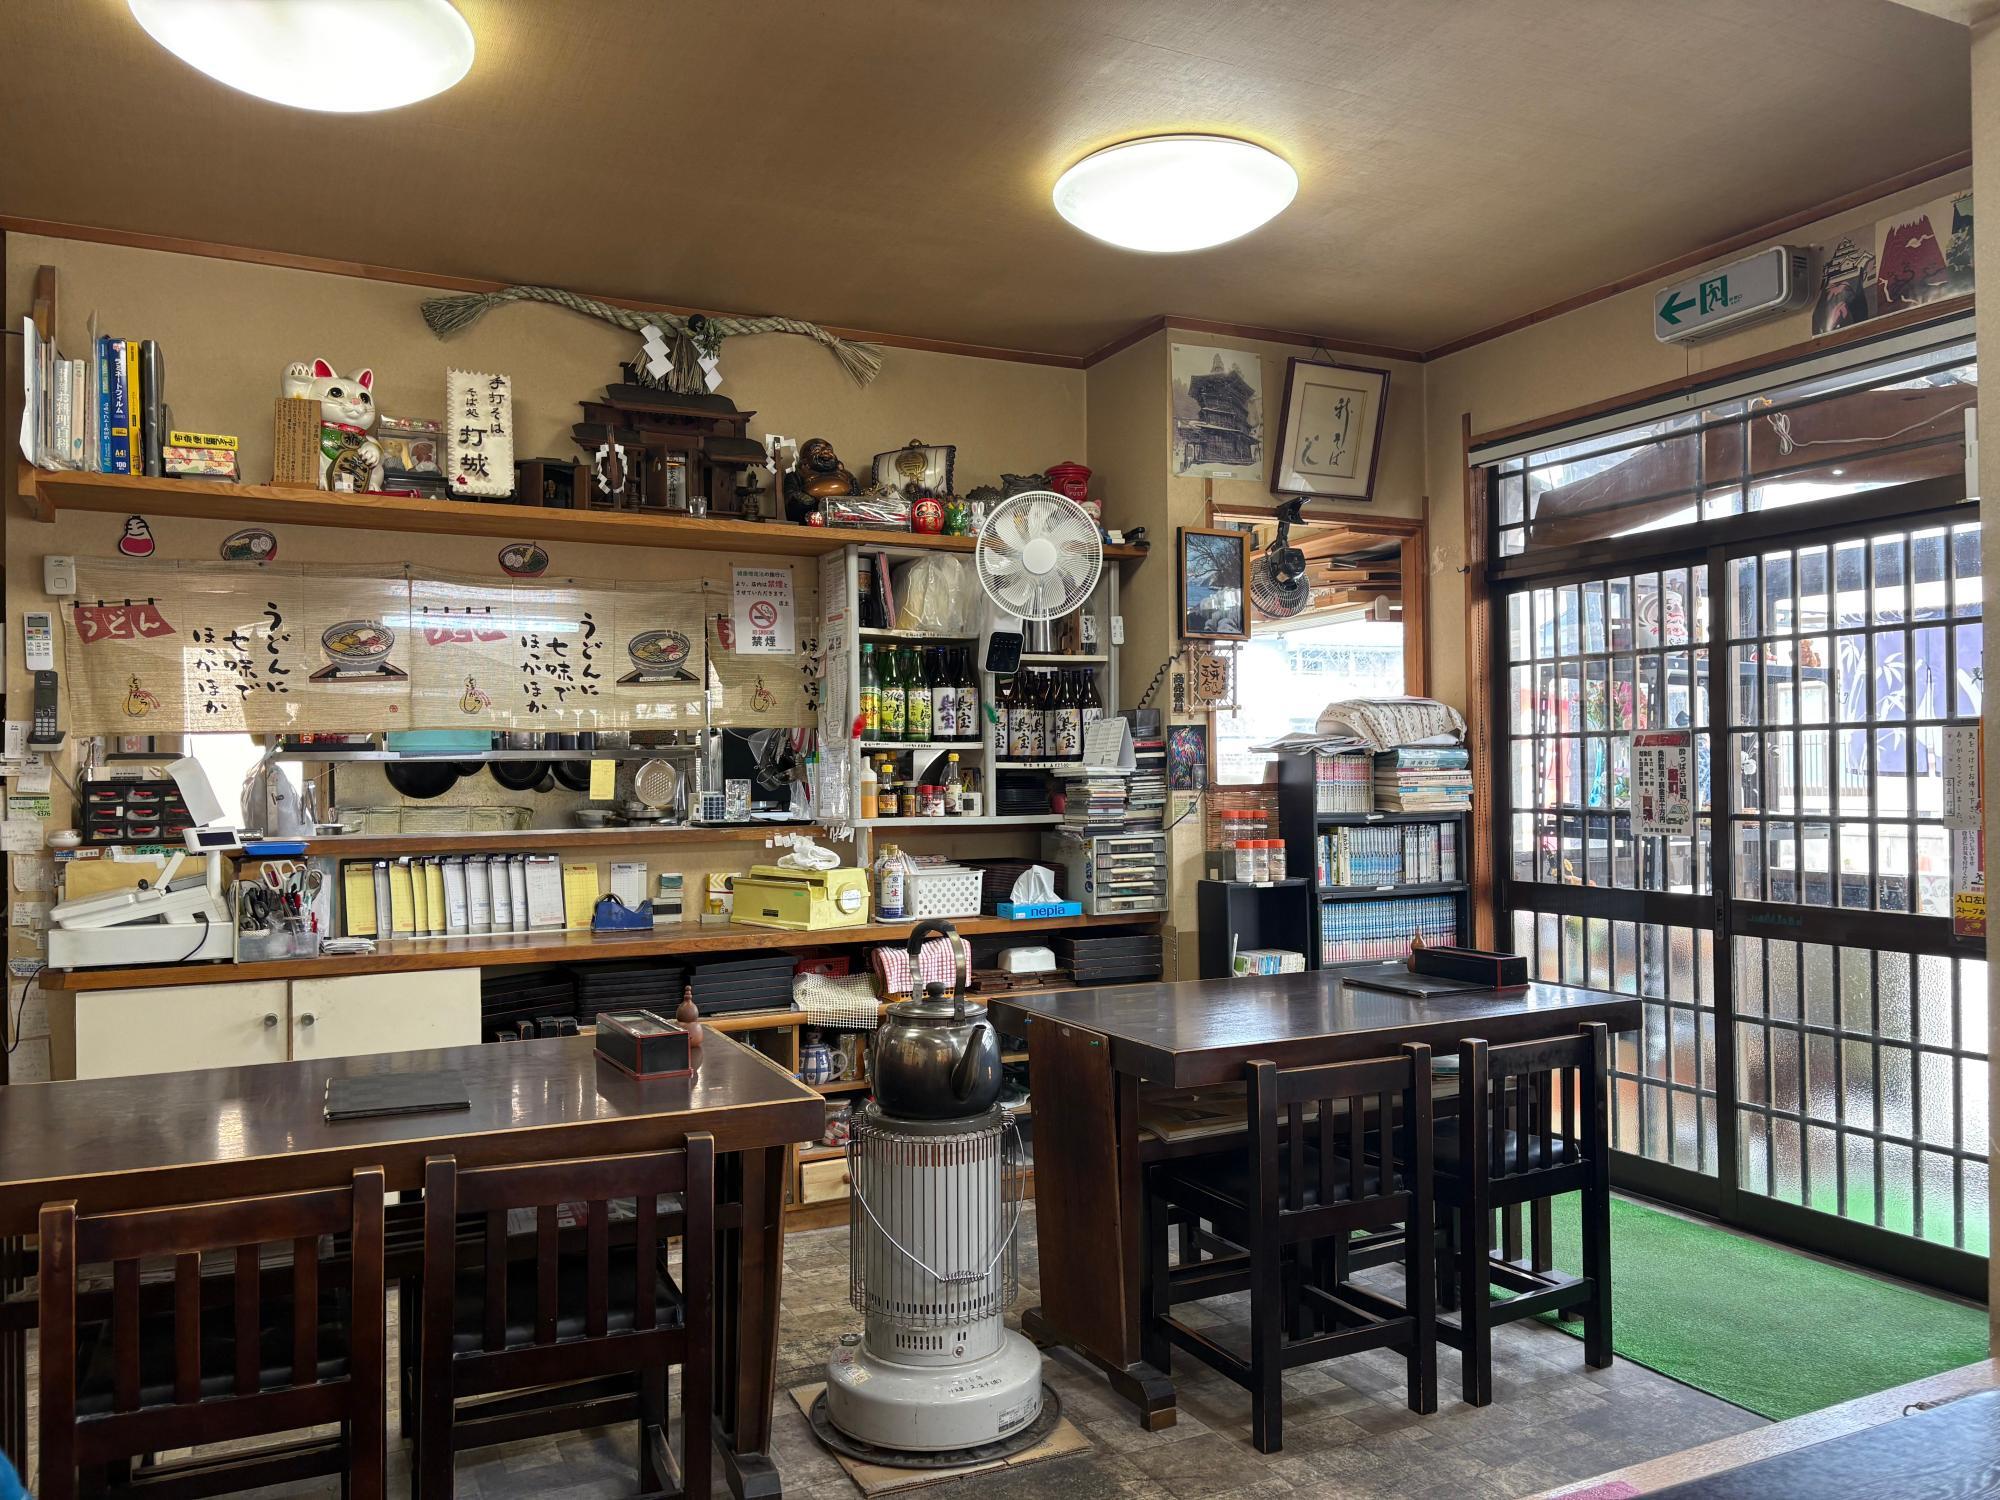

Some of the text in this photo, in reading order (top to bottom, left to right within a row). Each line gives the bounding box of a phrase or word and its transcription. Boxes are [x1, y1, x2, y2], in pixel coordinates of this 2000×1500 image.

[459, 426, 489, 478] 打城
[82, 608, 161, 637] うどん
[263, 601, 291, 694] うどんに
[751, 636, 776, 647] 禁煙
[222, 630, 261, 700] 七味で
[545, 637, 576, 702] 七味で
[580, 612, 603, 696] うどんに
[956, 695, 974, 730] 財宝
[1031, 904, 1066, 917] nepia
